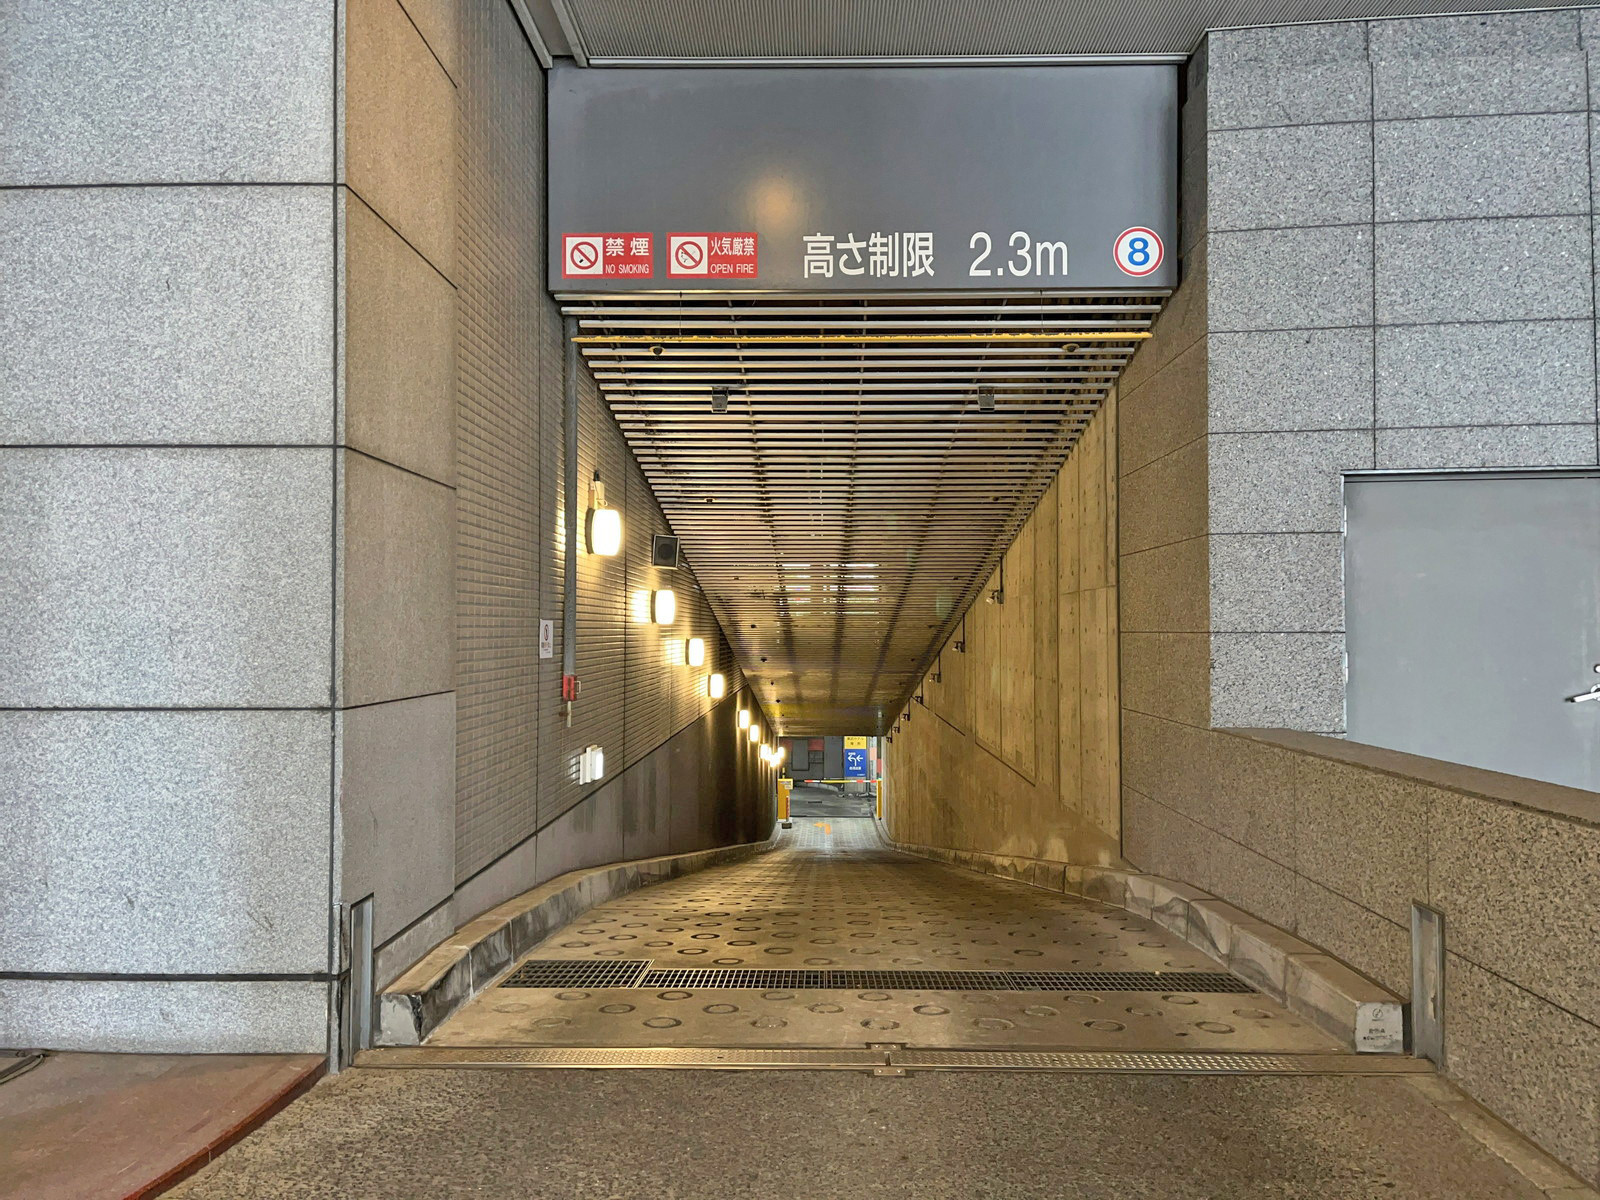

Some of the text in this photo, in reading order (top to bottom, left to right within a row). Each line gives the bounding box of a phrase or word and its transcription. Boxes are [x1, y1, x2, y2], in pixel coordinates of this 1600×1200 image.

[710, 237, 755, 256] 火気厳禁
[802, 231, 1068, 279] 高さ制限 2.3m
[1127, 237, 1150, 267] 8
[605, 264, 649, 274] NO SMOKING
[710, 263, 754, 274] OPEN FIRE
